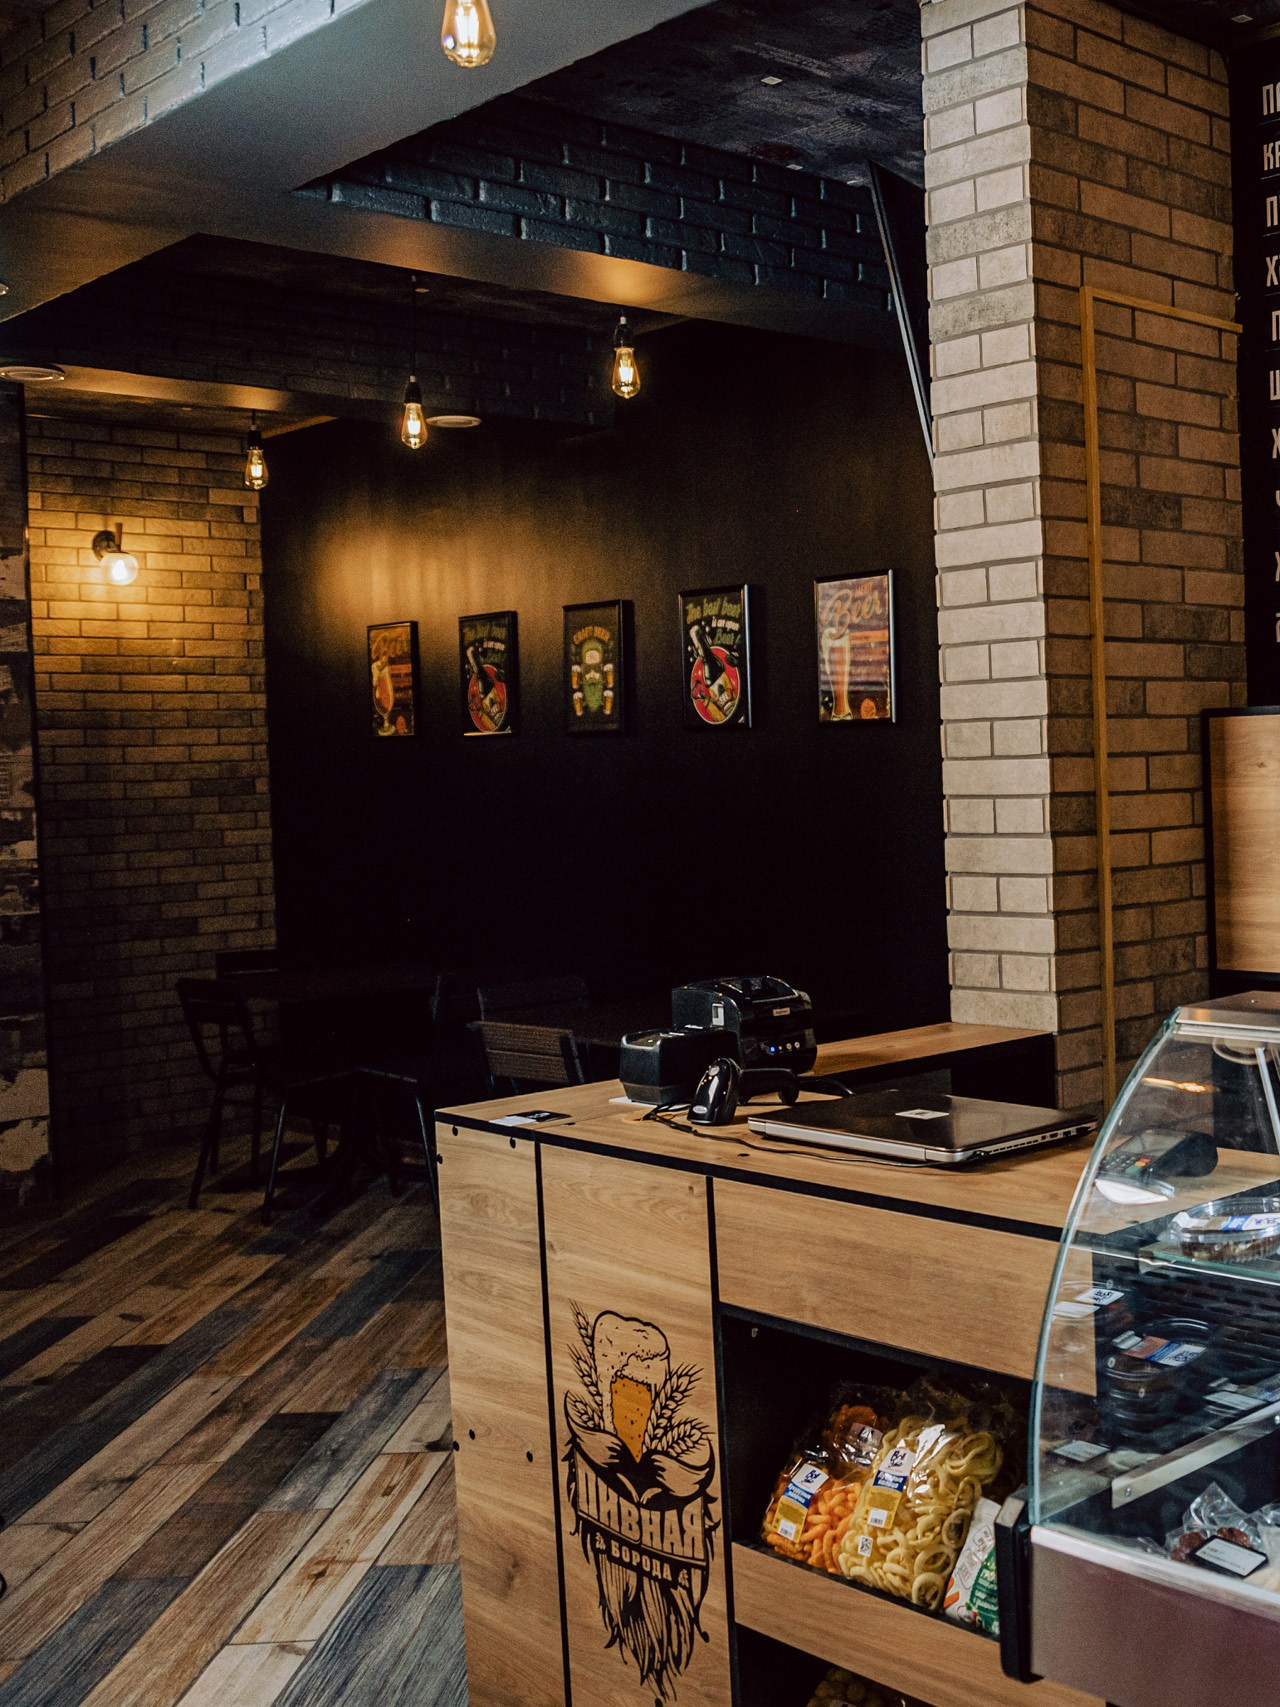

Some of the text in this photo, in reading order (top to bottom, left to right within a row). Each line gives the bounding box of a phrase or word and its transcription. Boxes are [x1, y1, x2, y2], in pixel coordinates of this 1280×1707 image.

[820, 588, 882, 640] Beer
[577, 1454, 705, 1560] ПИВНАЯ
[611, 1540, 672, 1581] БОРОДА
